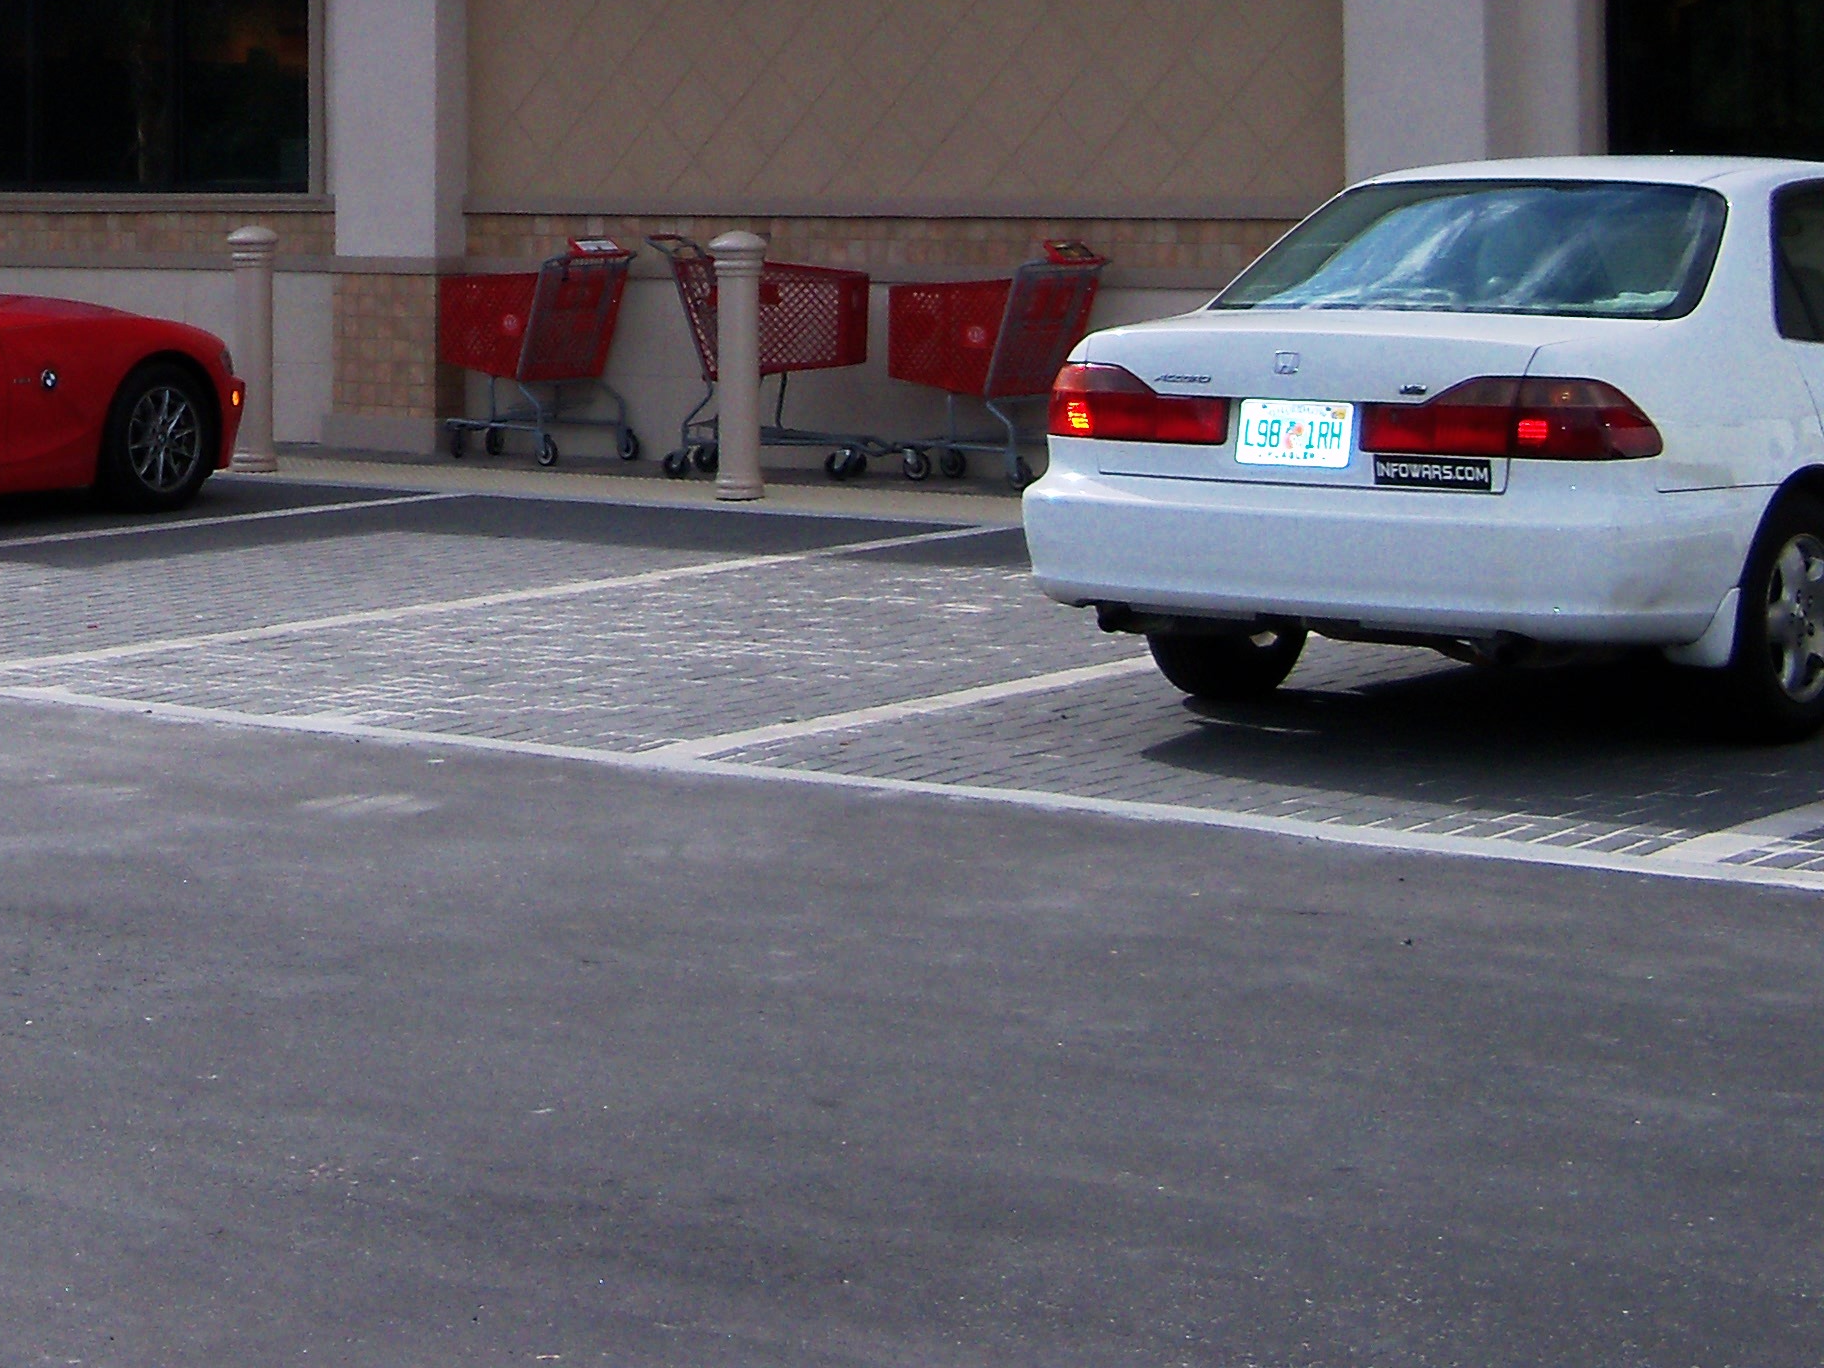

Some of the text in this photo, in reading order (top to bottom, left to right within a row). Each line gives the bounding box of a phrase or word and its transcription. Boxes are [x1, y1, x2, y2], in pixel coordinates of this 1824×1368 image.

[1244, 419, 1343, 450] L98 1RH
[1376, 461, 1489, 483] INFOWARS.COM
